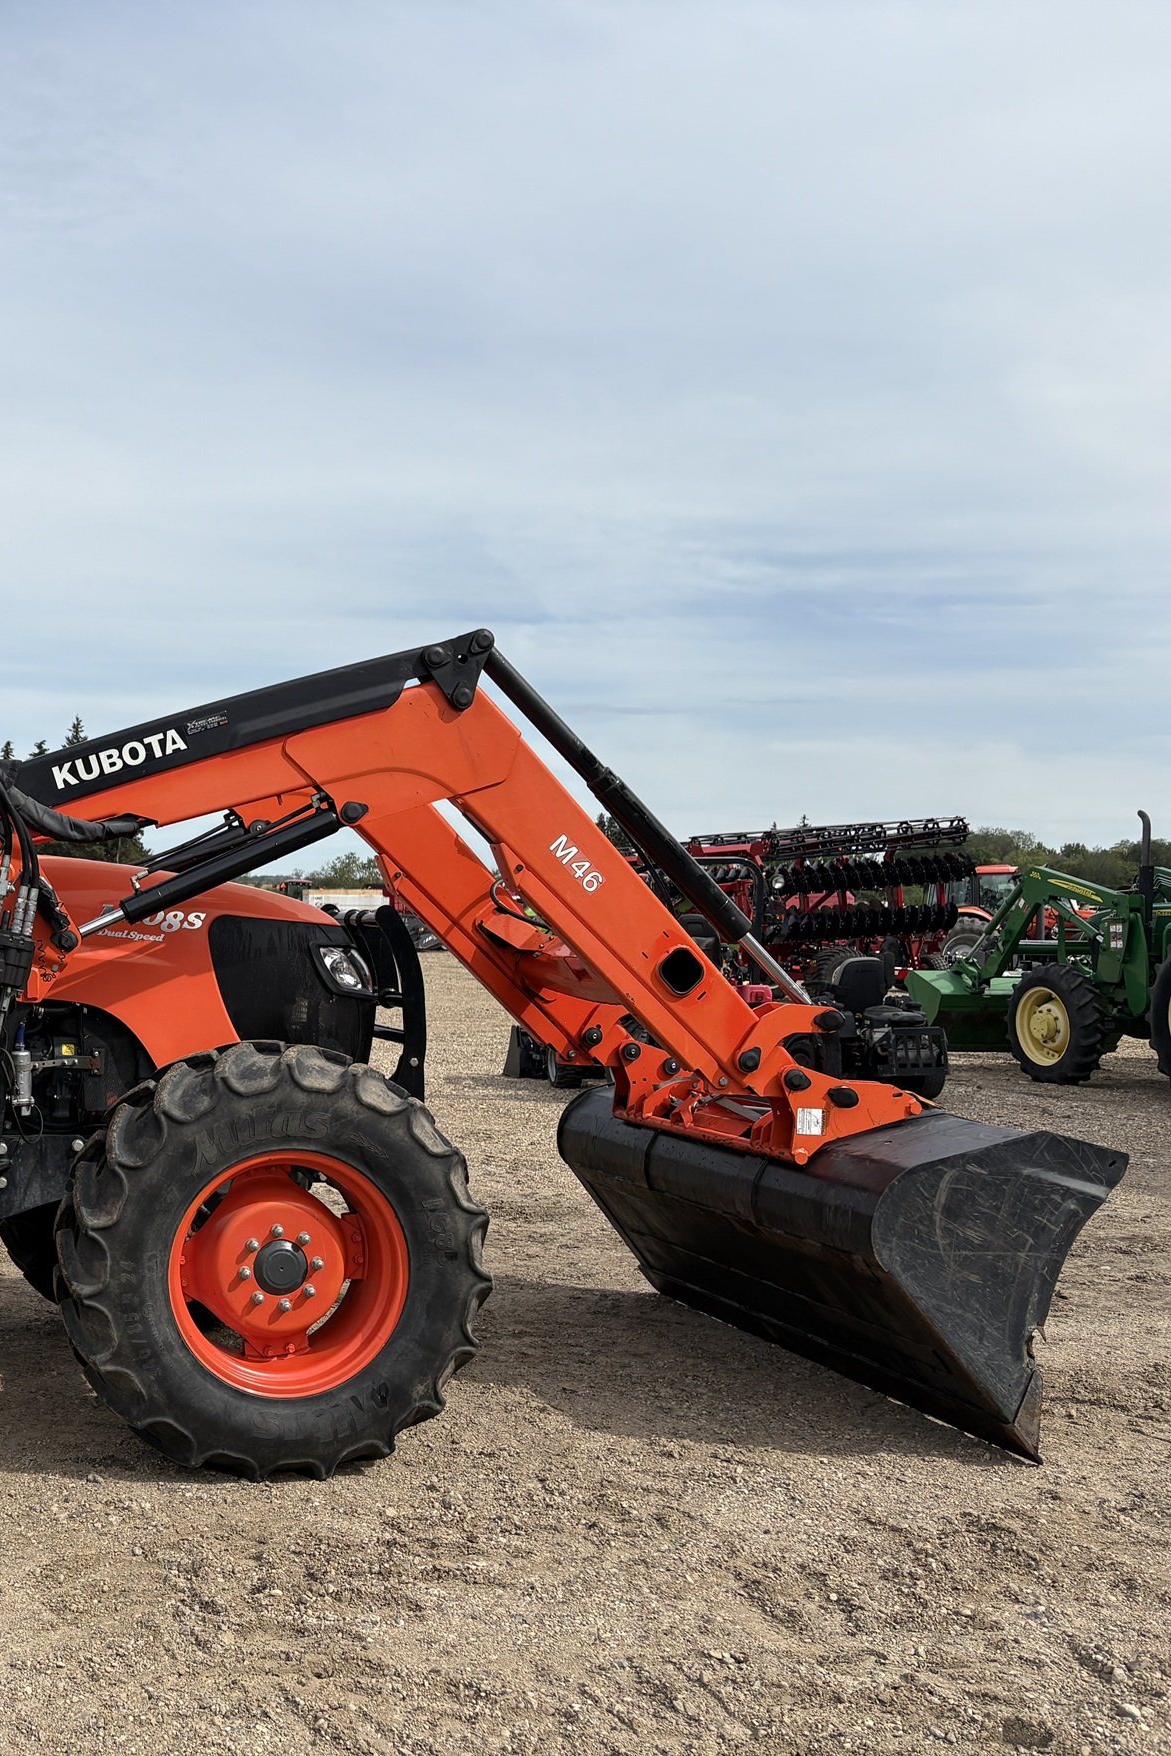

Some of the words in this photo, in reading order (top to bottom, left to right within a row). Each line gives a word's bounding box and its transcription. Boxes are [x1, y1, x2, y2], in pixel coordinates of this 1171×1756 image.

[52, 728, 188, 790] KUBOTA
[192, 1105, 331, 1177] Mitas
[253, 1382, 390, 1442] Mitas
